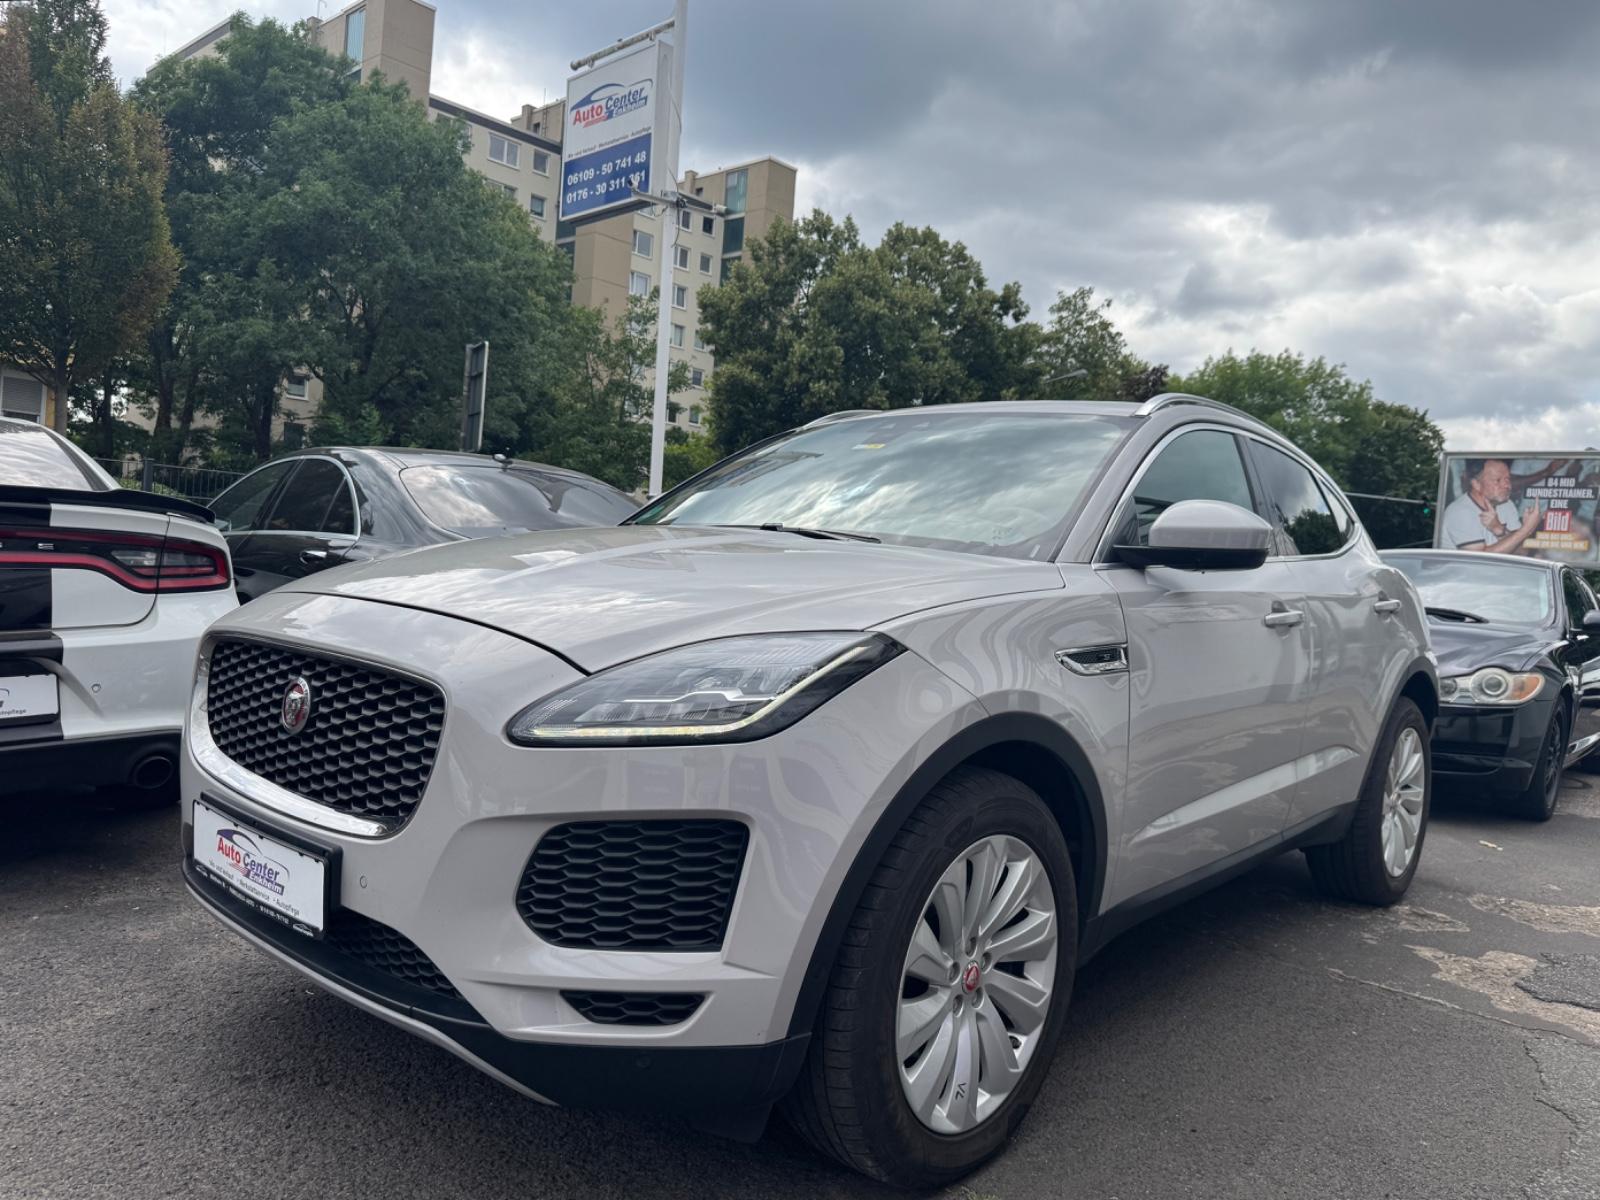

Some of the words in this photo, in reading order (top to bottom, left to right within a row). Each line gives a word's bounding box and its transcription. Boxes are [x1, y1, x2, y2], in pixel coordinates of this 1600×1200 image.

[573, 104, 604, 125] Auto
[605, 87, 644, 109] Center
[567, 168, 594, 185] 06109
[601, 162, 613, 176] 50
[615, 155, 632, 172] 741
[634, 150, 647, 165] 48
[567, 189, 588, 204] 0176
[595, 183, 607, 195] 30
[609, 176, 626, 191] 311
[1526, 488, 1594, 498] BUNDESTRAINER.
[1550, 499, 1569, 509] EINE
[1545, 512, 1569, 531] Bild
[217, 836, 241, 865] Auto
[243, 853, 280, 881] Center
